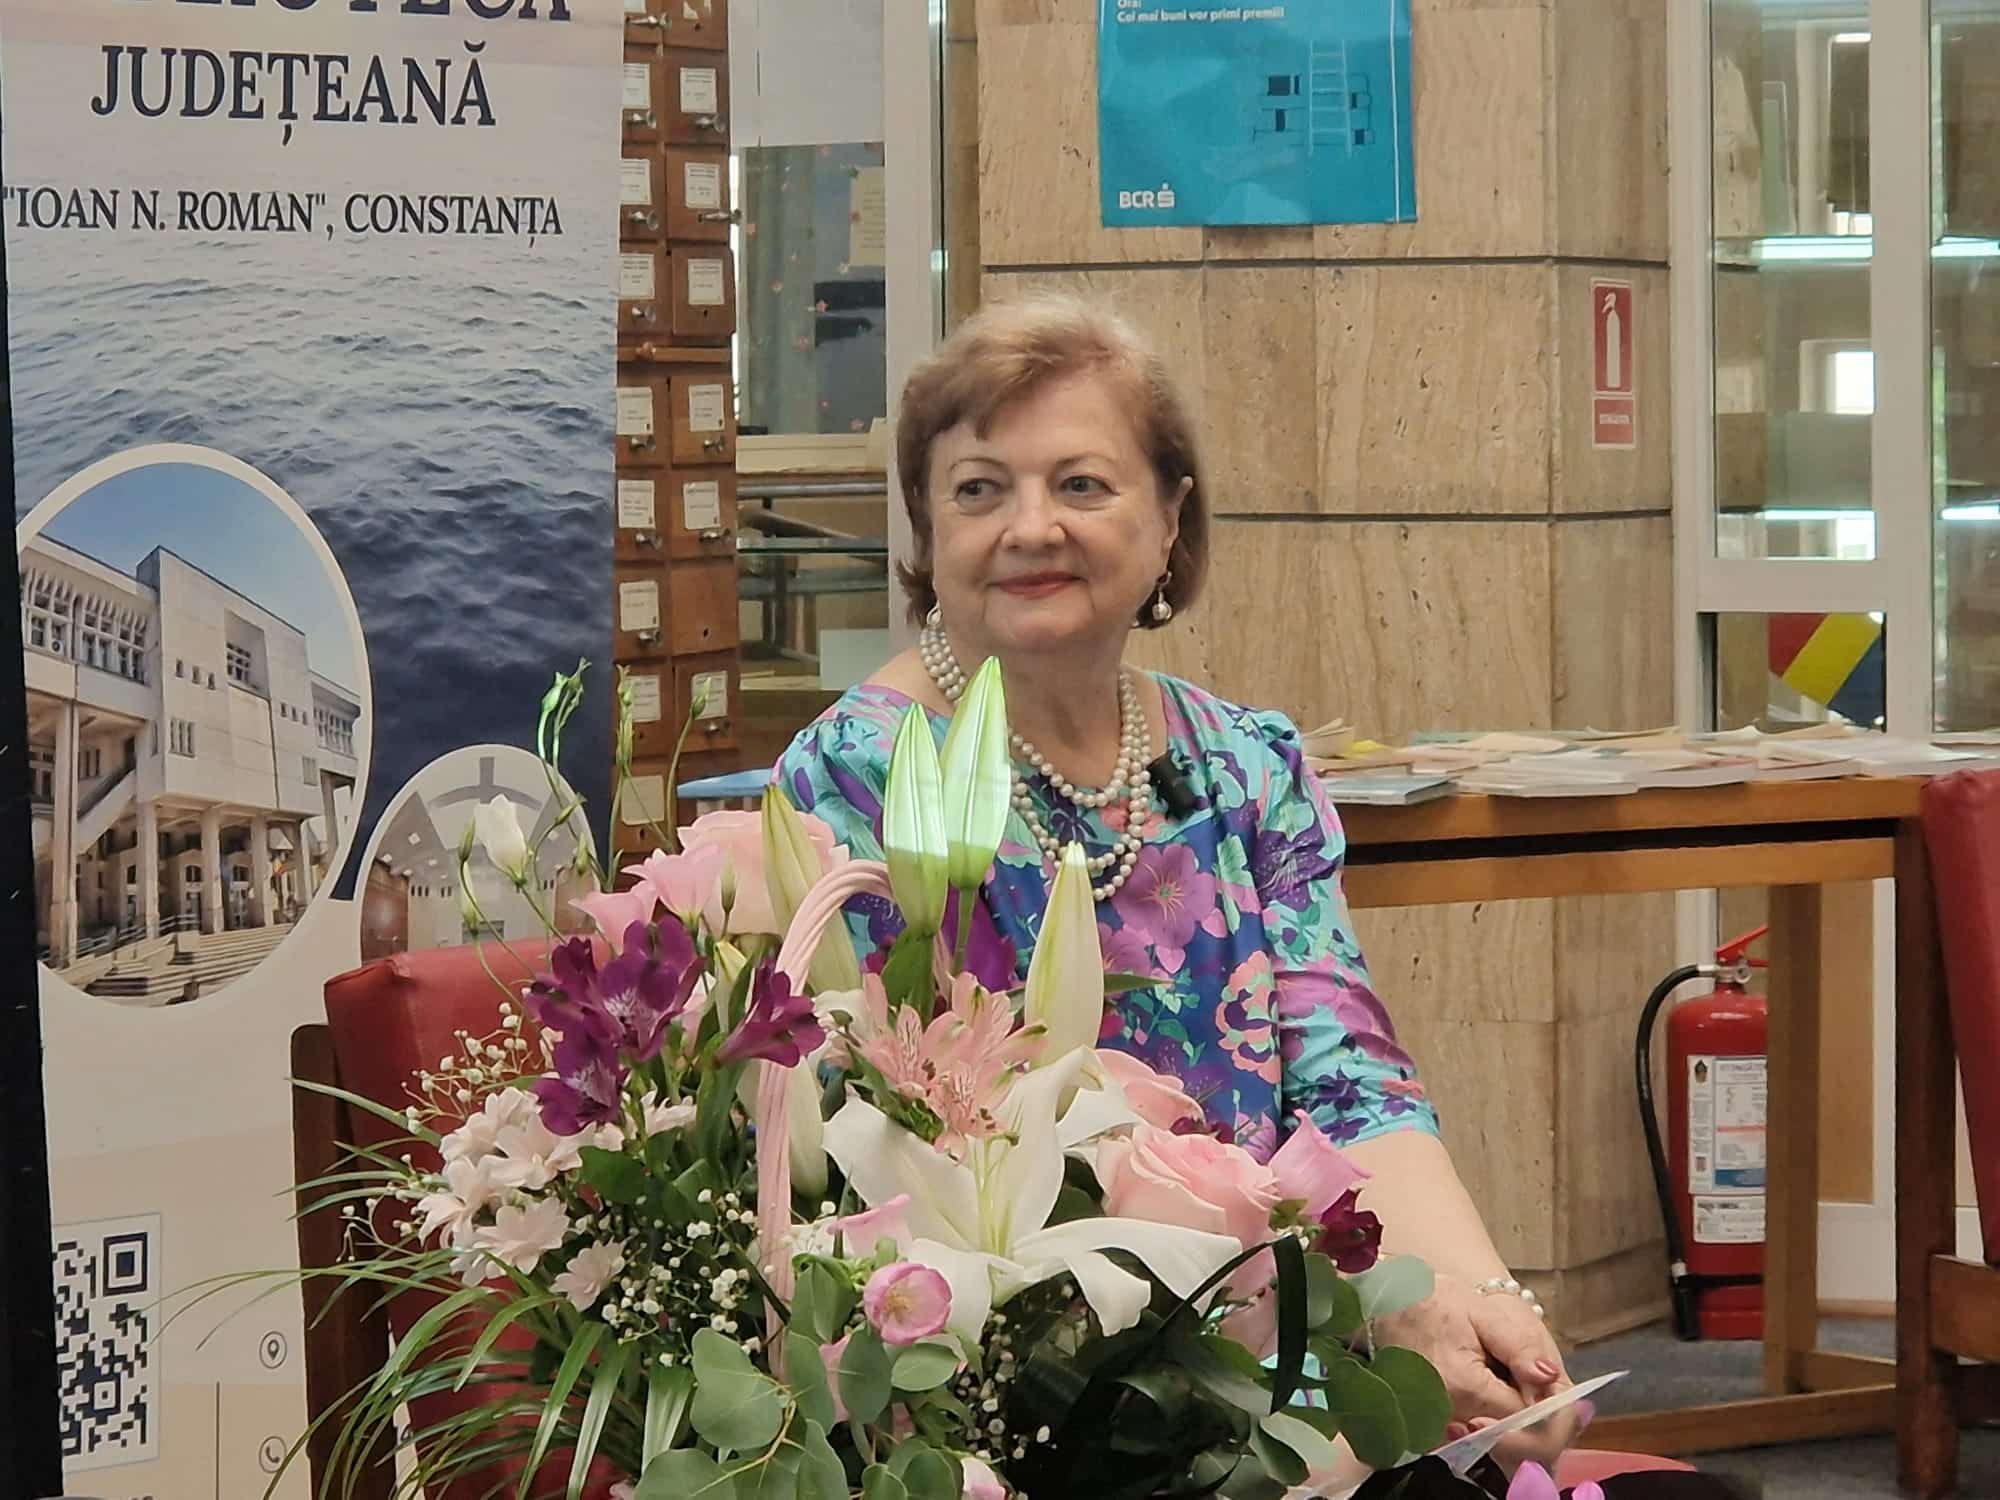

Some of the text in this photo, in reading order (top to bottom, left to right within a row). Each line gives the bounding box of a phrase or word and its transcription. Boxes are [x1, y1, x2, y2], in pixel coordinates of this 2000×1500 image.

[1160, 9, 1187, 22] buni
[1188, 10, 1209, 20] vor
[2, 186, 120, 230] "IOAN
[131, 190, 166, 231] N.
[1119, 191, 1155, 209] BCR
